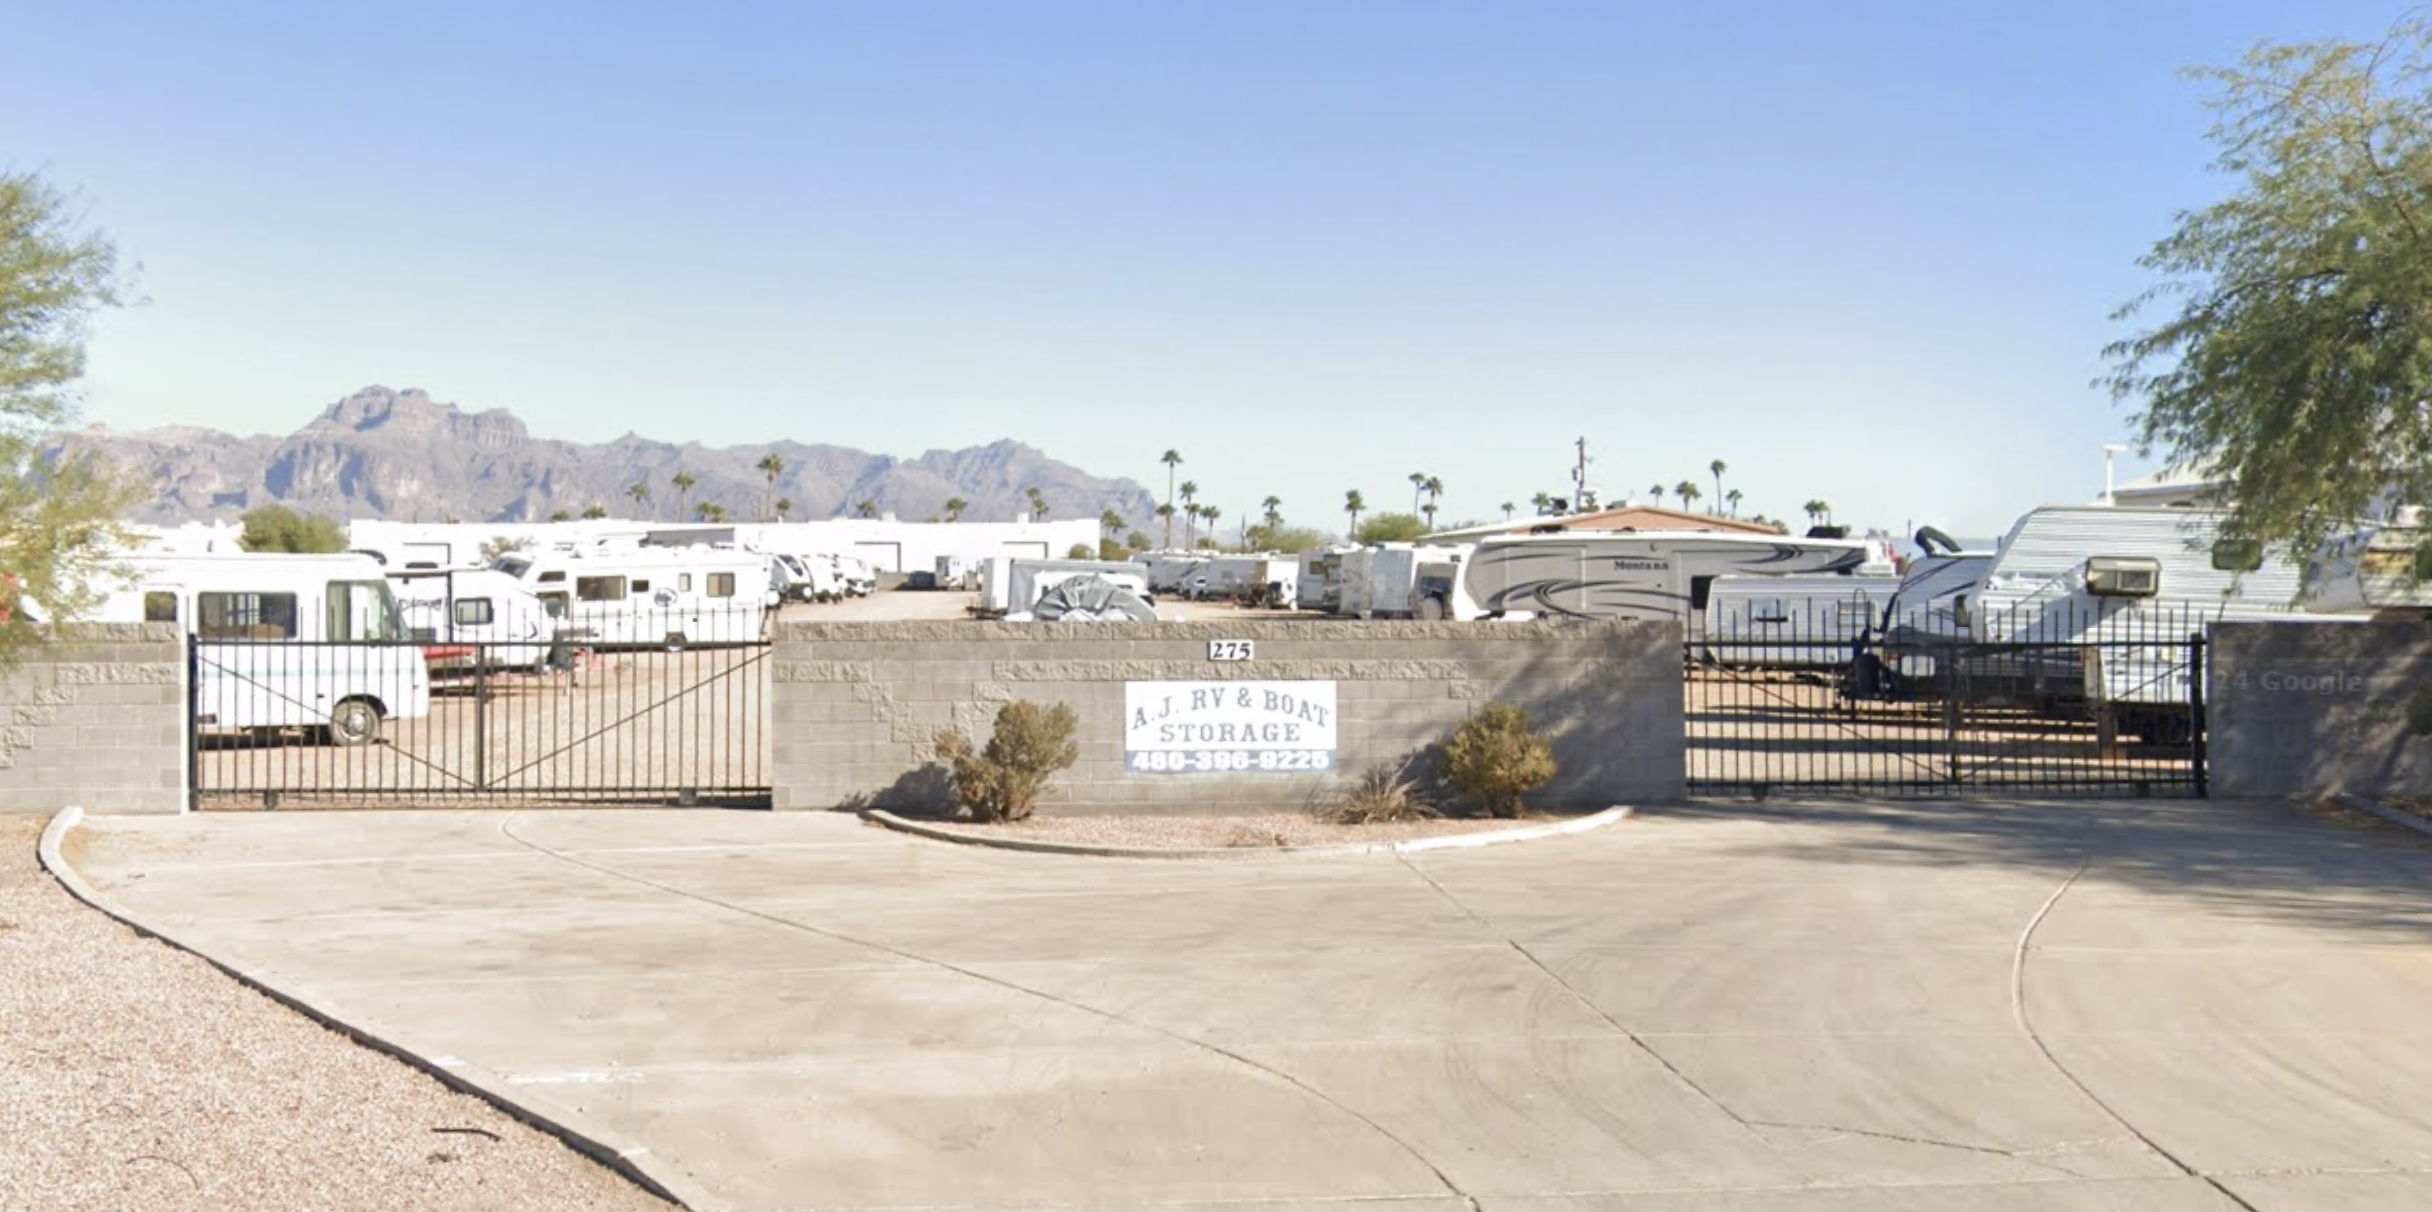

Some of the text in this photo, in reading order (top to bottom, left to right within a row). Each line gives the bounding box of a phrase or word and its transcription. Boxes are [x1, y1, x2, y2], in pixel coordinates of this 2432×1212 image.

[1213, 642, 1251, 661] 275
[1191, 688, 1226, 711] RV
[1237, 687, 1253, 708] &
[1263, 690, 1329, 727] BOAT
[1160, 723, 1301, 743] STORAGE
